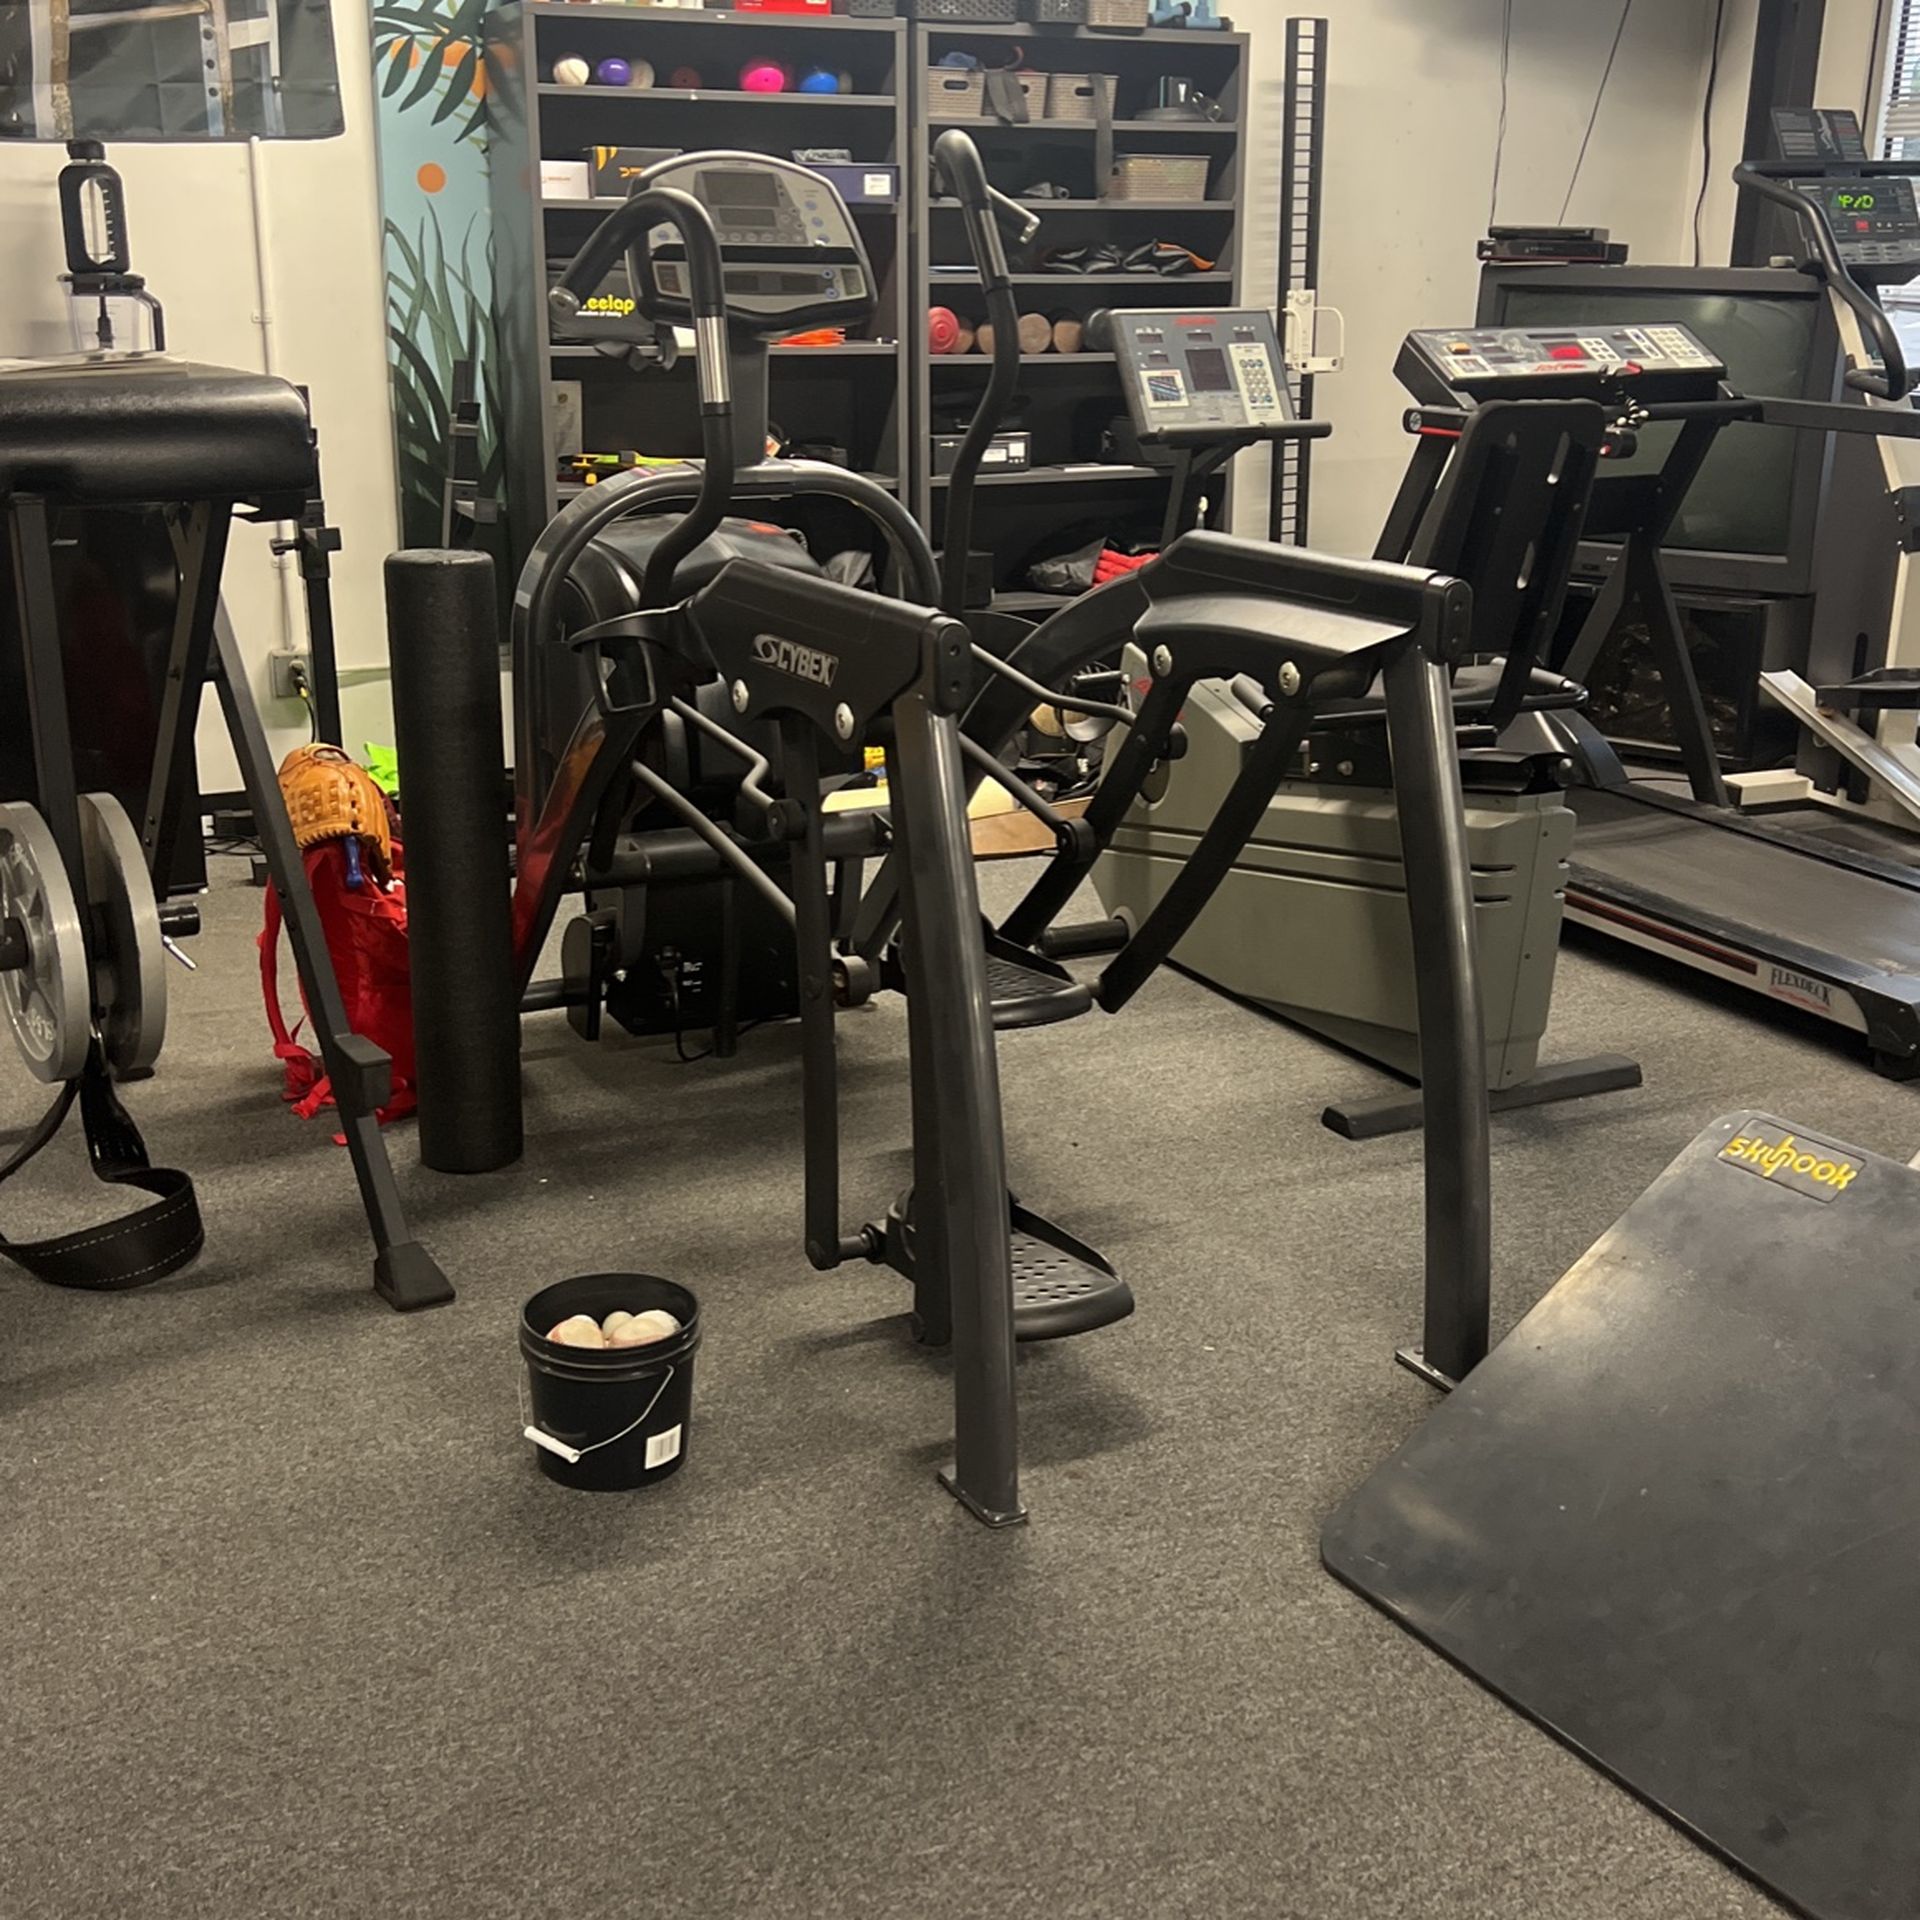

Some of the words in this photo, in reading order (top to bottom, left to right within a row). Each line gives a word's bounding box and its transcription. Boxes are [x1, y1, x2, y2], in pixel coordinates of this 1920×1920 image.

[582, 294, 636, 316] eelap
[777, 641, 834, 688] CYBEX
[1770, 967, 1833, 1007] FLEXDECK
[1726, 1135, 1858, 1191] skyhook
